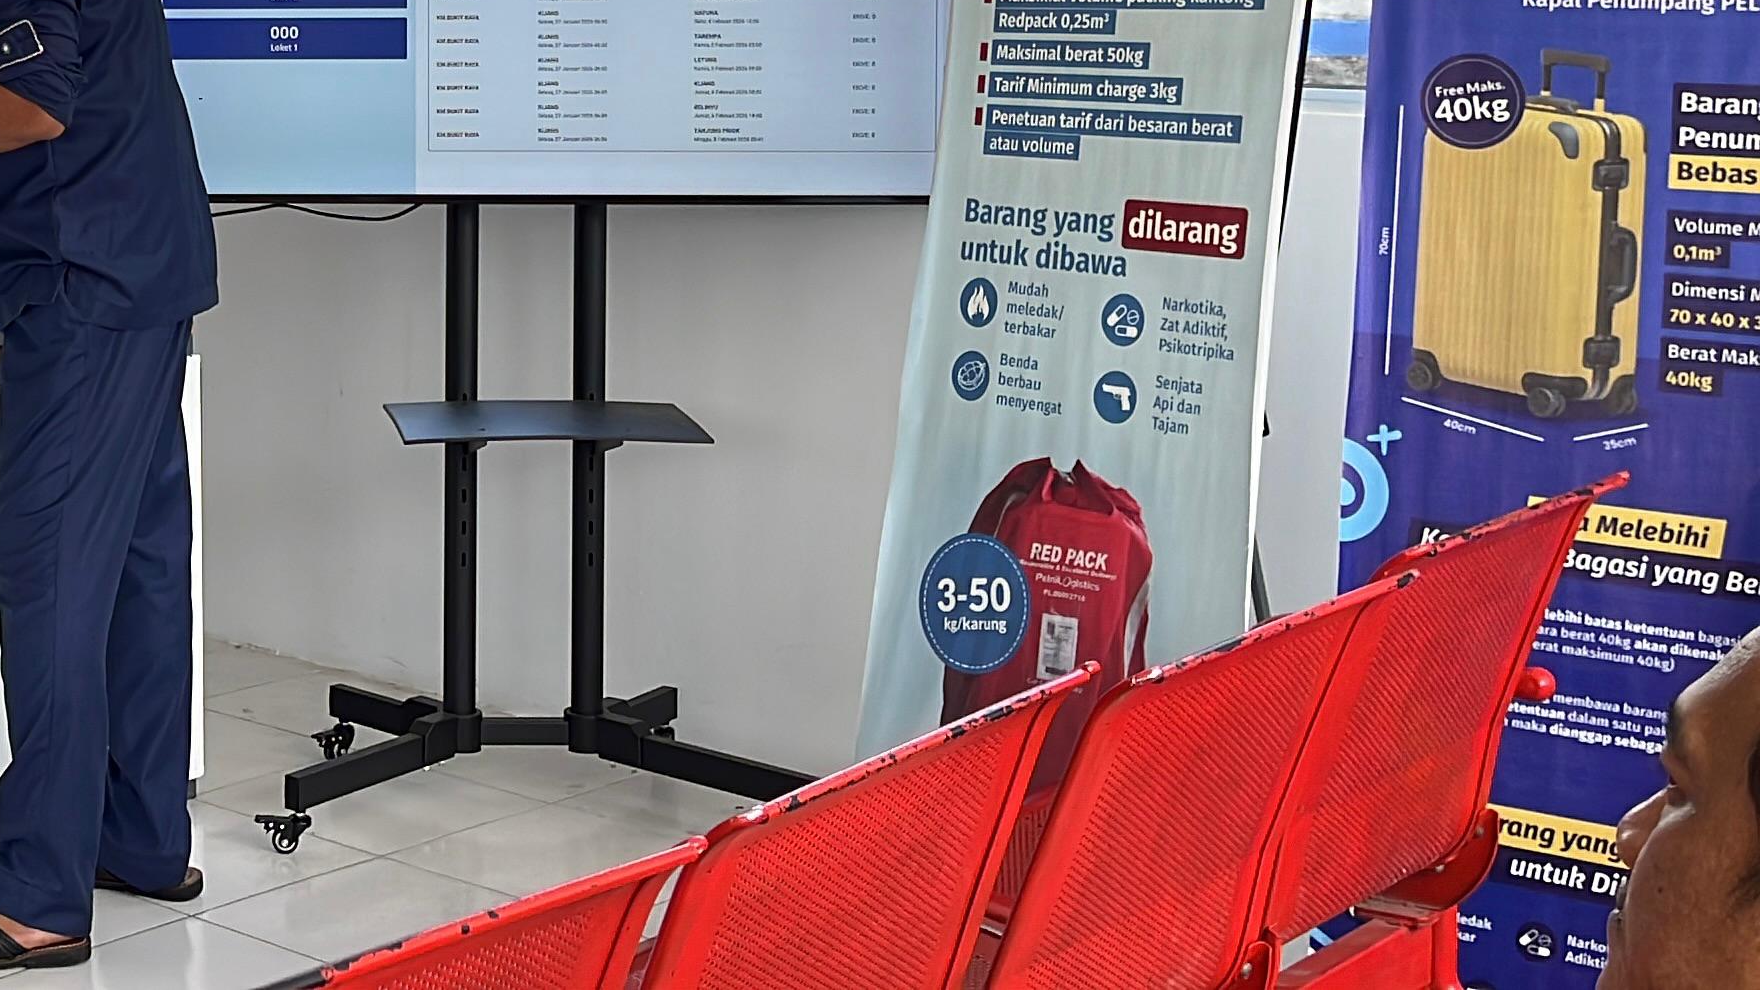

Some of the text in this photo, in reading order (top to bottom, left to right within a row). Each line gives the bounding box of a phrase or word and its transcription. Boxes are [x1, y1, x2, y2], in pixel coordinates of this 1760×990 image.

[270, 26, 299, 40] 000
[998, 13, 1057, 32] Redpack
[996, 43, 1145, 67] Maksimal berat 50kg
[994, 76, 1178, 102] Tarif Minimum charge 3kg
[1435, 80, 1506, 97] Free Maks.
[1434, 95, 1511, 124] 40kg
[991, 110, 1234, 137] Penetuan tarif dari besaran berat
[989, 136, 1075, 155] atau volume
[1677, 162, 1758, 185] Bebas
[964, 198, 1240, 254] Barang yang dilarang
[1674, 217, 1743, 237] Volume
[1378, 226, 1390, 256] 70cm
[960, 239, 1128, 278] untuk dibawa
[1007, 281, 1049, 298] Mudah
[1671, 281, 1745, 301] Dimensi
[1006, 301, 1065, 321] meledak/
[1161, 297, 1227, 319] Narkotika,
[1669, 309, 1692, 324] 70
[1695, 313, 1706, 325] x
[1710, 312, 1734, 327] 40
[1738, 315, 1750, 328] x
[1004, 321, 1056, 340] terbakar
[1159, 317, 1228, 342] Zat Adiktif,
[1158, 337, 1234, 362] Psikotripika
[1668, 344, 1717, 362] Berat
[999, 353, 1039, 371] Benda
[998, 372, 1042, 391] berbau
[1155, 375, 1204, 395] Senjata
[1664, 370, 1713, 392] 40kg
[996, 394, 1062, 416] menyengat
[1152, 396, 1201, 415] Api dan
[1151, 416, 1189, 435] Tajam
[1443, 418, 1477, 436] 40cm
[1602, 436, 1637, 451] 35cm
[1595, 515, 1710, 548] Melebihi
[1030, 542, 1062, 563] RED
[1065, 548, 1108, 571] PACK
[1651, 563, 1719, 594] yang
[937, 577, 1011, 612] 3-50
[943, 616, 1007, 634] kg/karung
[1584, 613, 1695, 641] batas ketentuan
[1560, 627, 1668, 654] berat 40kg akan
[1561, 642, 1676, 673] maksimum 40kg)
[1553, 694, 1620, 713] membawa
[1511, 719, 1612, 746] maka dianggap
[1567, 712, 1641, 733] dalam satu
[1510, 858, 1586, 889] untuk
